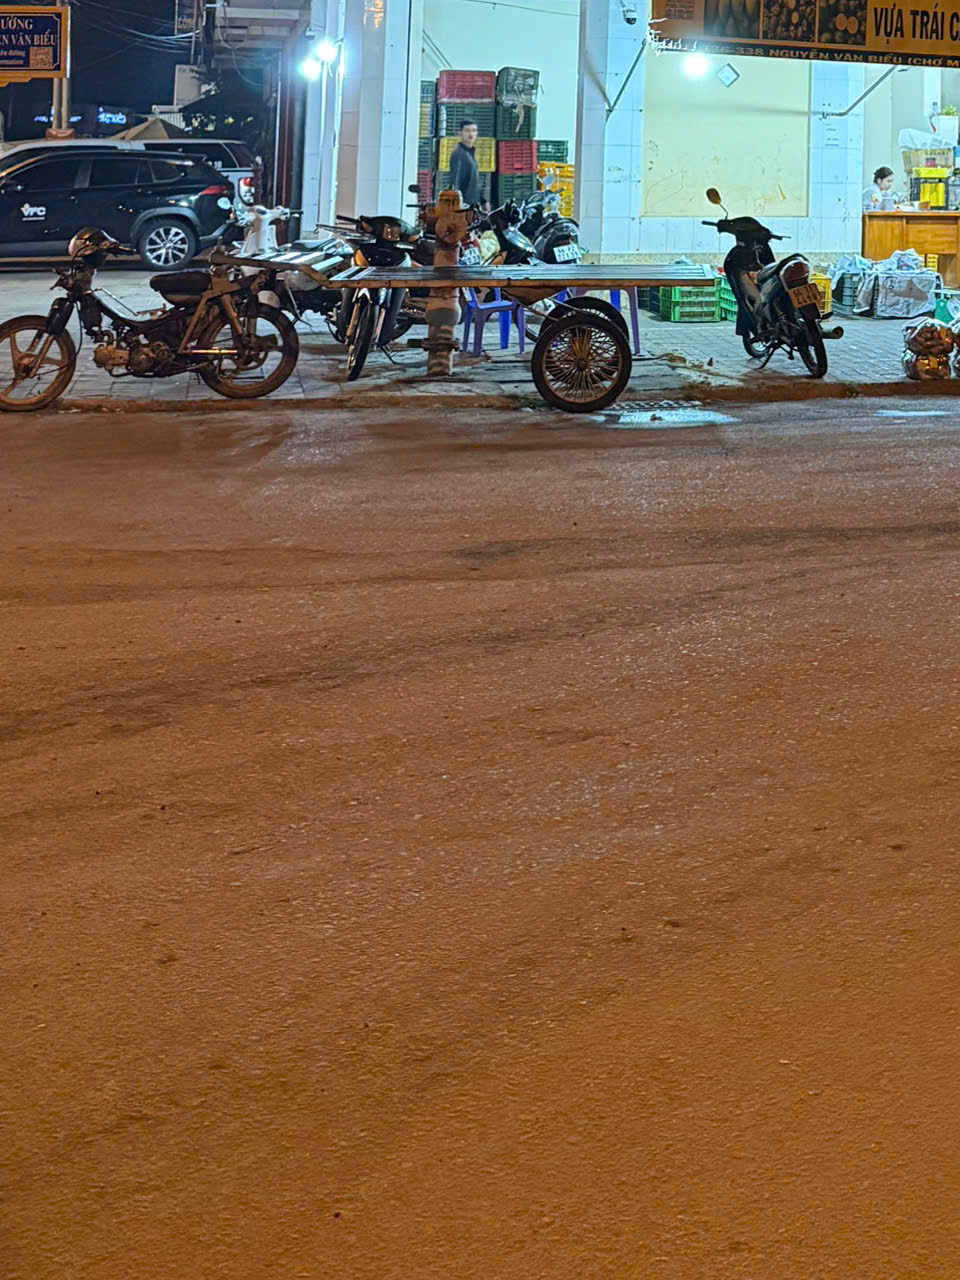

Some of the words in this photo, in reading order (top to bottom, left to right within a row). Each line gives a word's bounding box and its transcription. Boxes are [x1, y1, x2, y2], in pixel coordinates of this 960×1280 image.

[873, 2, 904, 45] VỰA
[909, 2, 945, 40] TRÁI
[11, 32, 31, 46] VĂN
[20, 205, 46, 217] VFC
